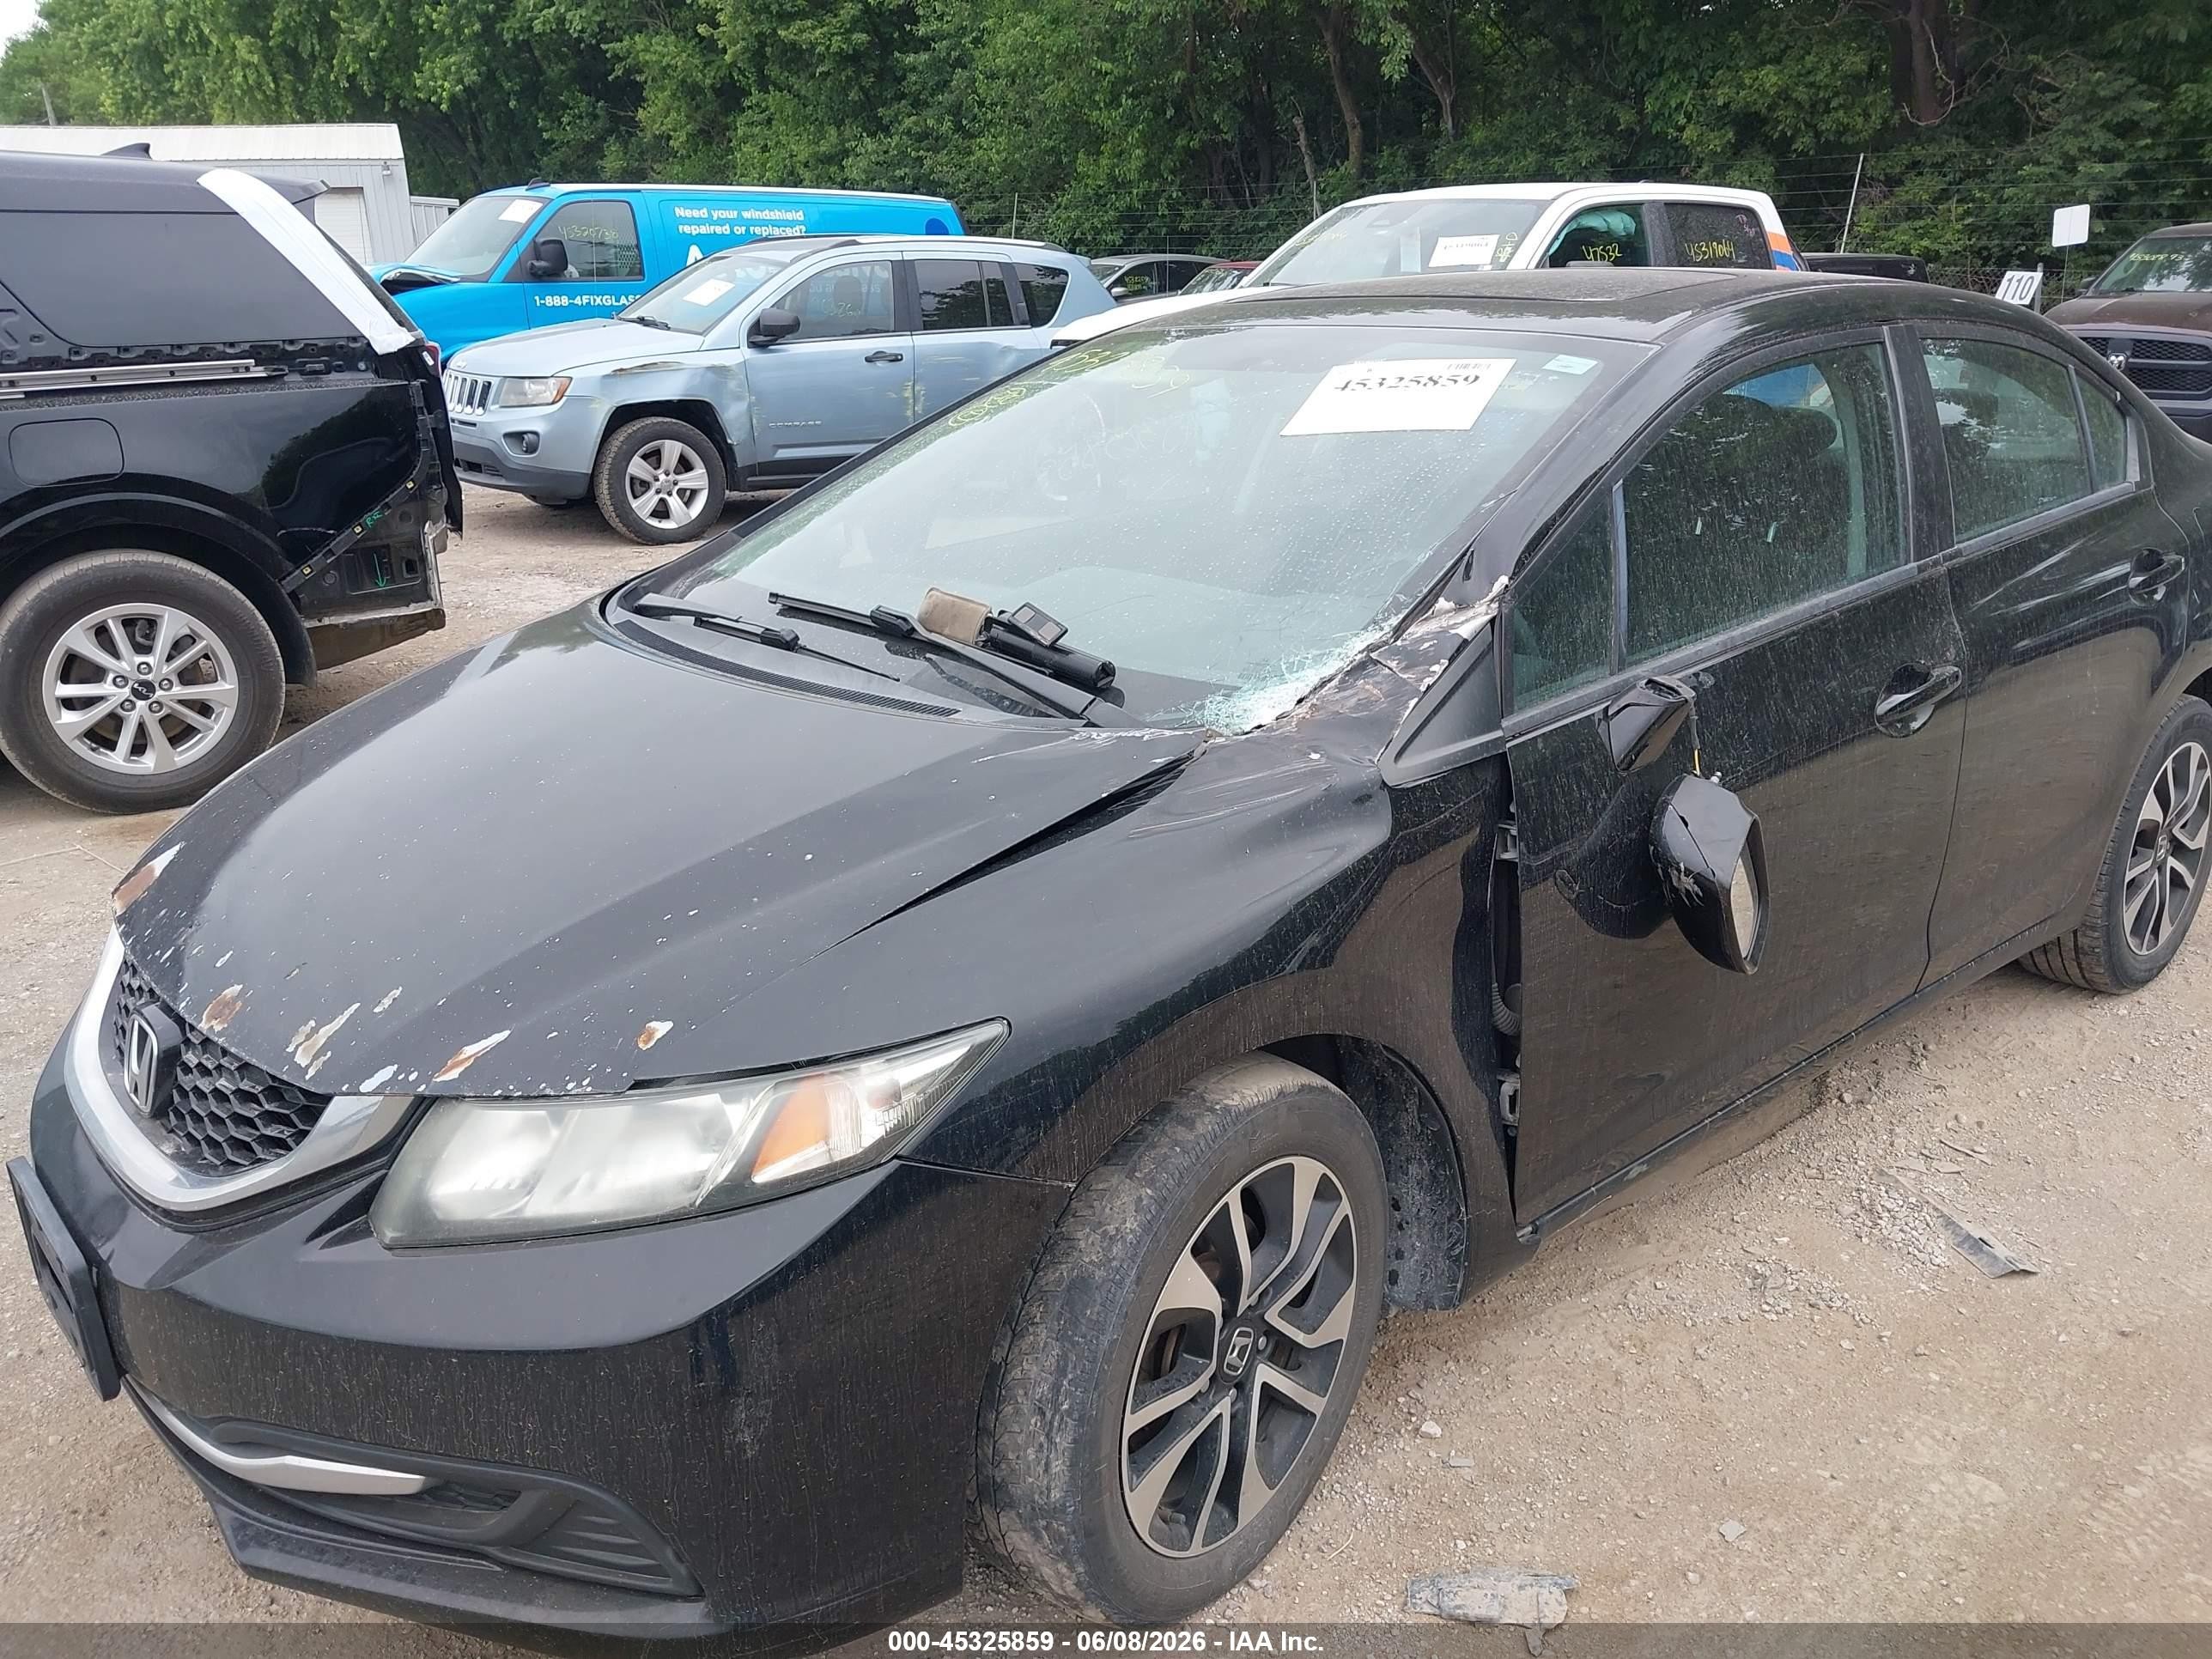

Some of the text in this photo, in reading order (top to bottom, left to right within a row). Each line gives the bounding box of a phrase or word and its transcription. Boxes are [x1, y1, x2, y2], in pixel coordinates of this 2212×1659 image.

[674, 206, 805, 221] Need your windshield
[678, 223, 731, 236] repaired
[750, 224, 806, 237] replaced?
[2002, 274, 2035, 301] 110
[1334, 374, 1480, 392] 45325859
